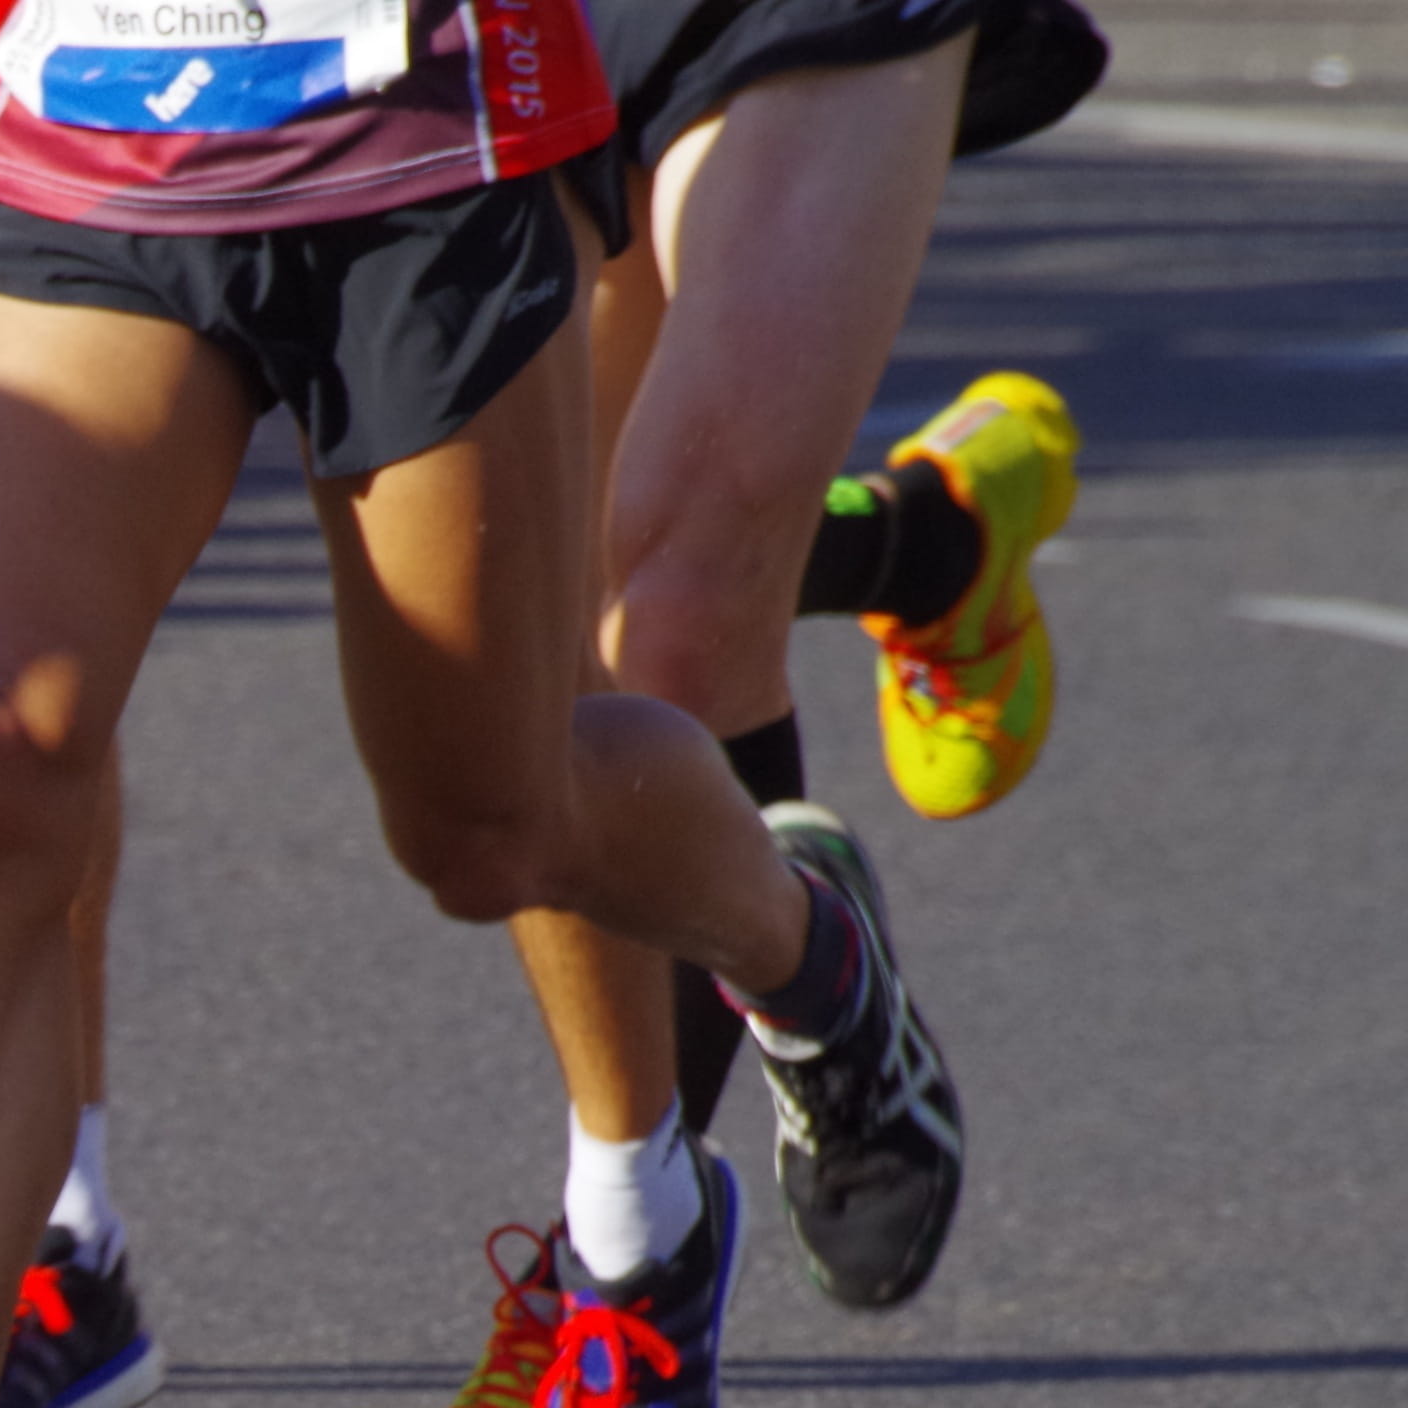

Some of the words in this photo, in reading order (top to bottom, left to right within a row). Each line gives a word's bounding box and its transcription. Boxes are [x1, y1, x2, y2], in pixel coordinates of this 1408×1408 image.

[92, 4, 144, 36] Yen
[153, 4, 267, 42] Ching
[502, 23, 546, 119] 2015
